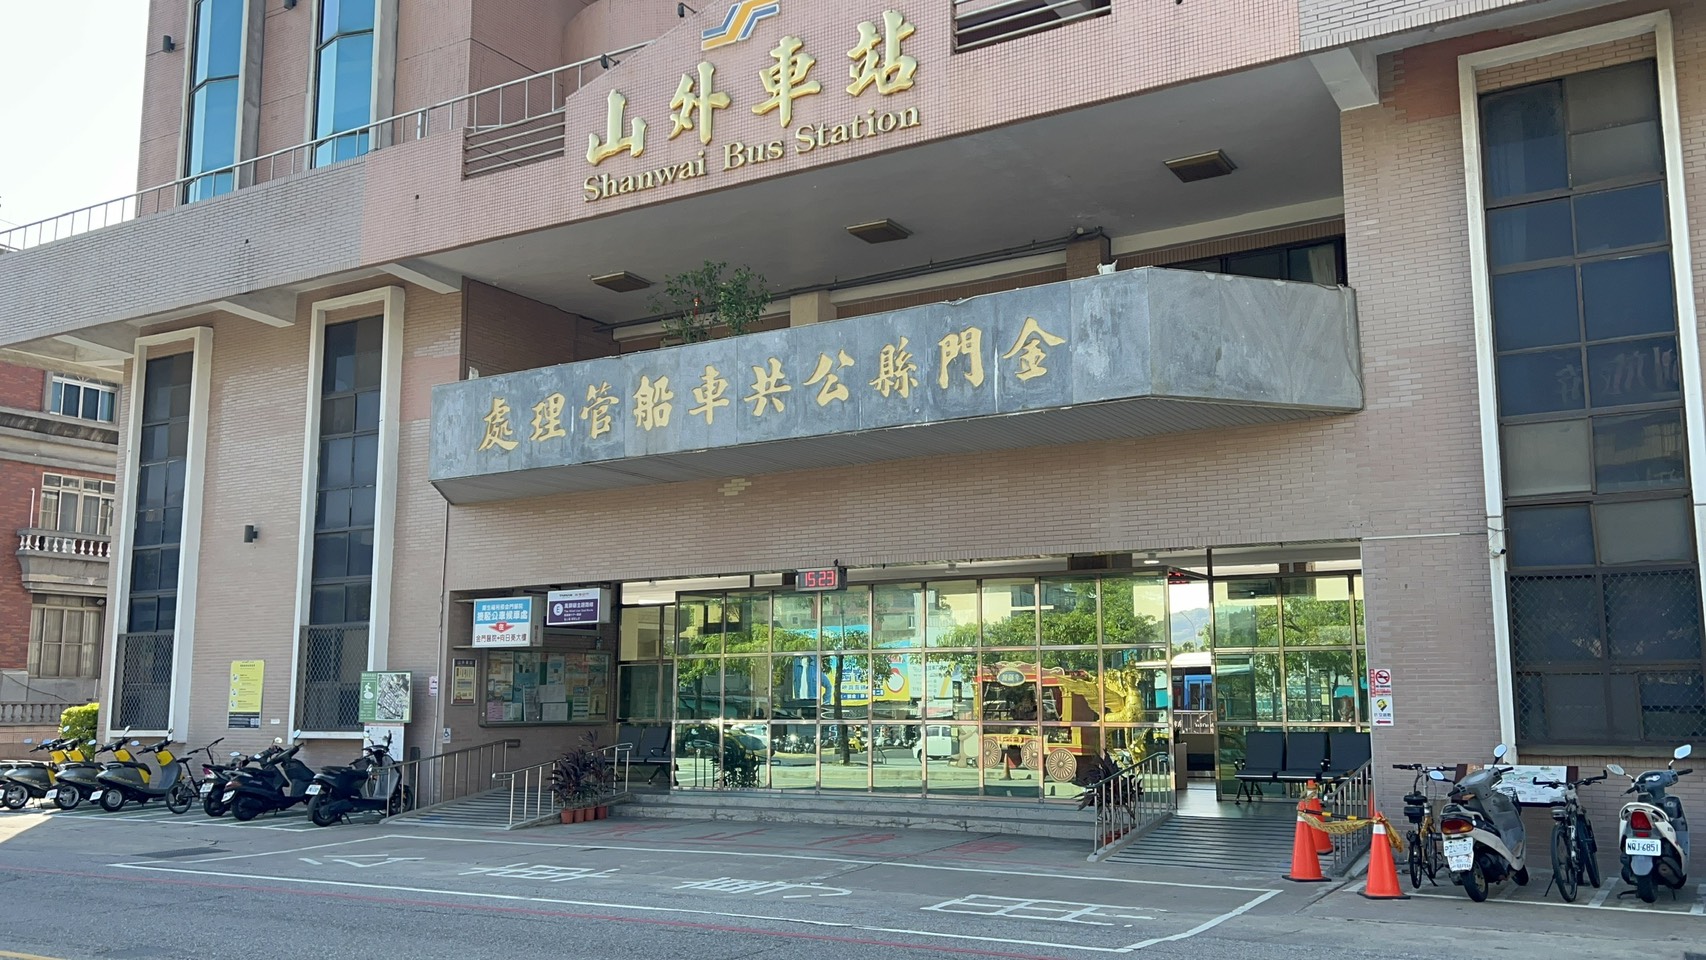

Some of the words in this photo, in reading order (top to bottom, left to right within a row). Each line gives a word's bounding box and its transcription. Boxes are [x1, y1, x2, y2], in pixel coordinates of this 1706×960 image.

[583, 151, 707, 203] Shanwai
[722, 138, 785, 171] Bus
[794, 106, 921, 155] Station
[585, 9, 918, 166] 山外車站
[478, 316, 1067, 453] 金門縣公共車船管理處
